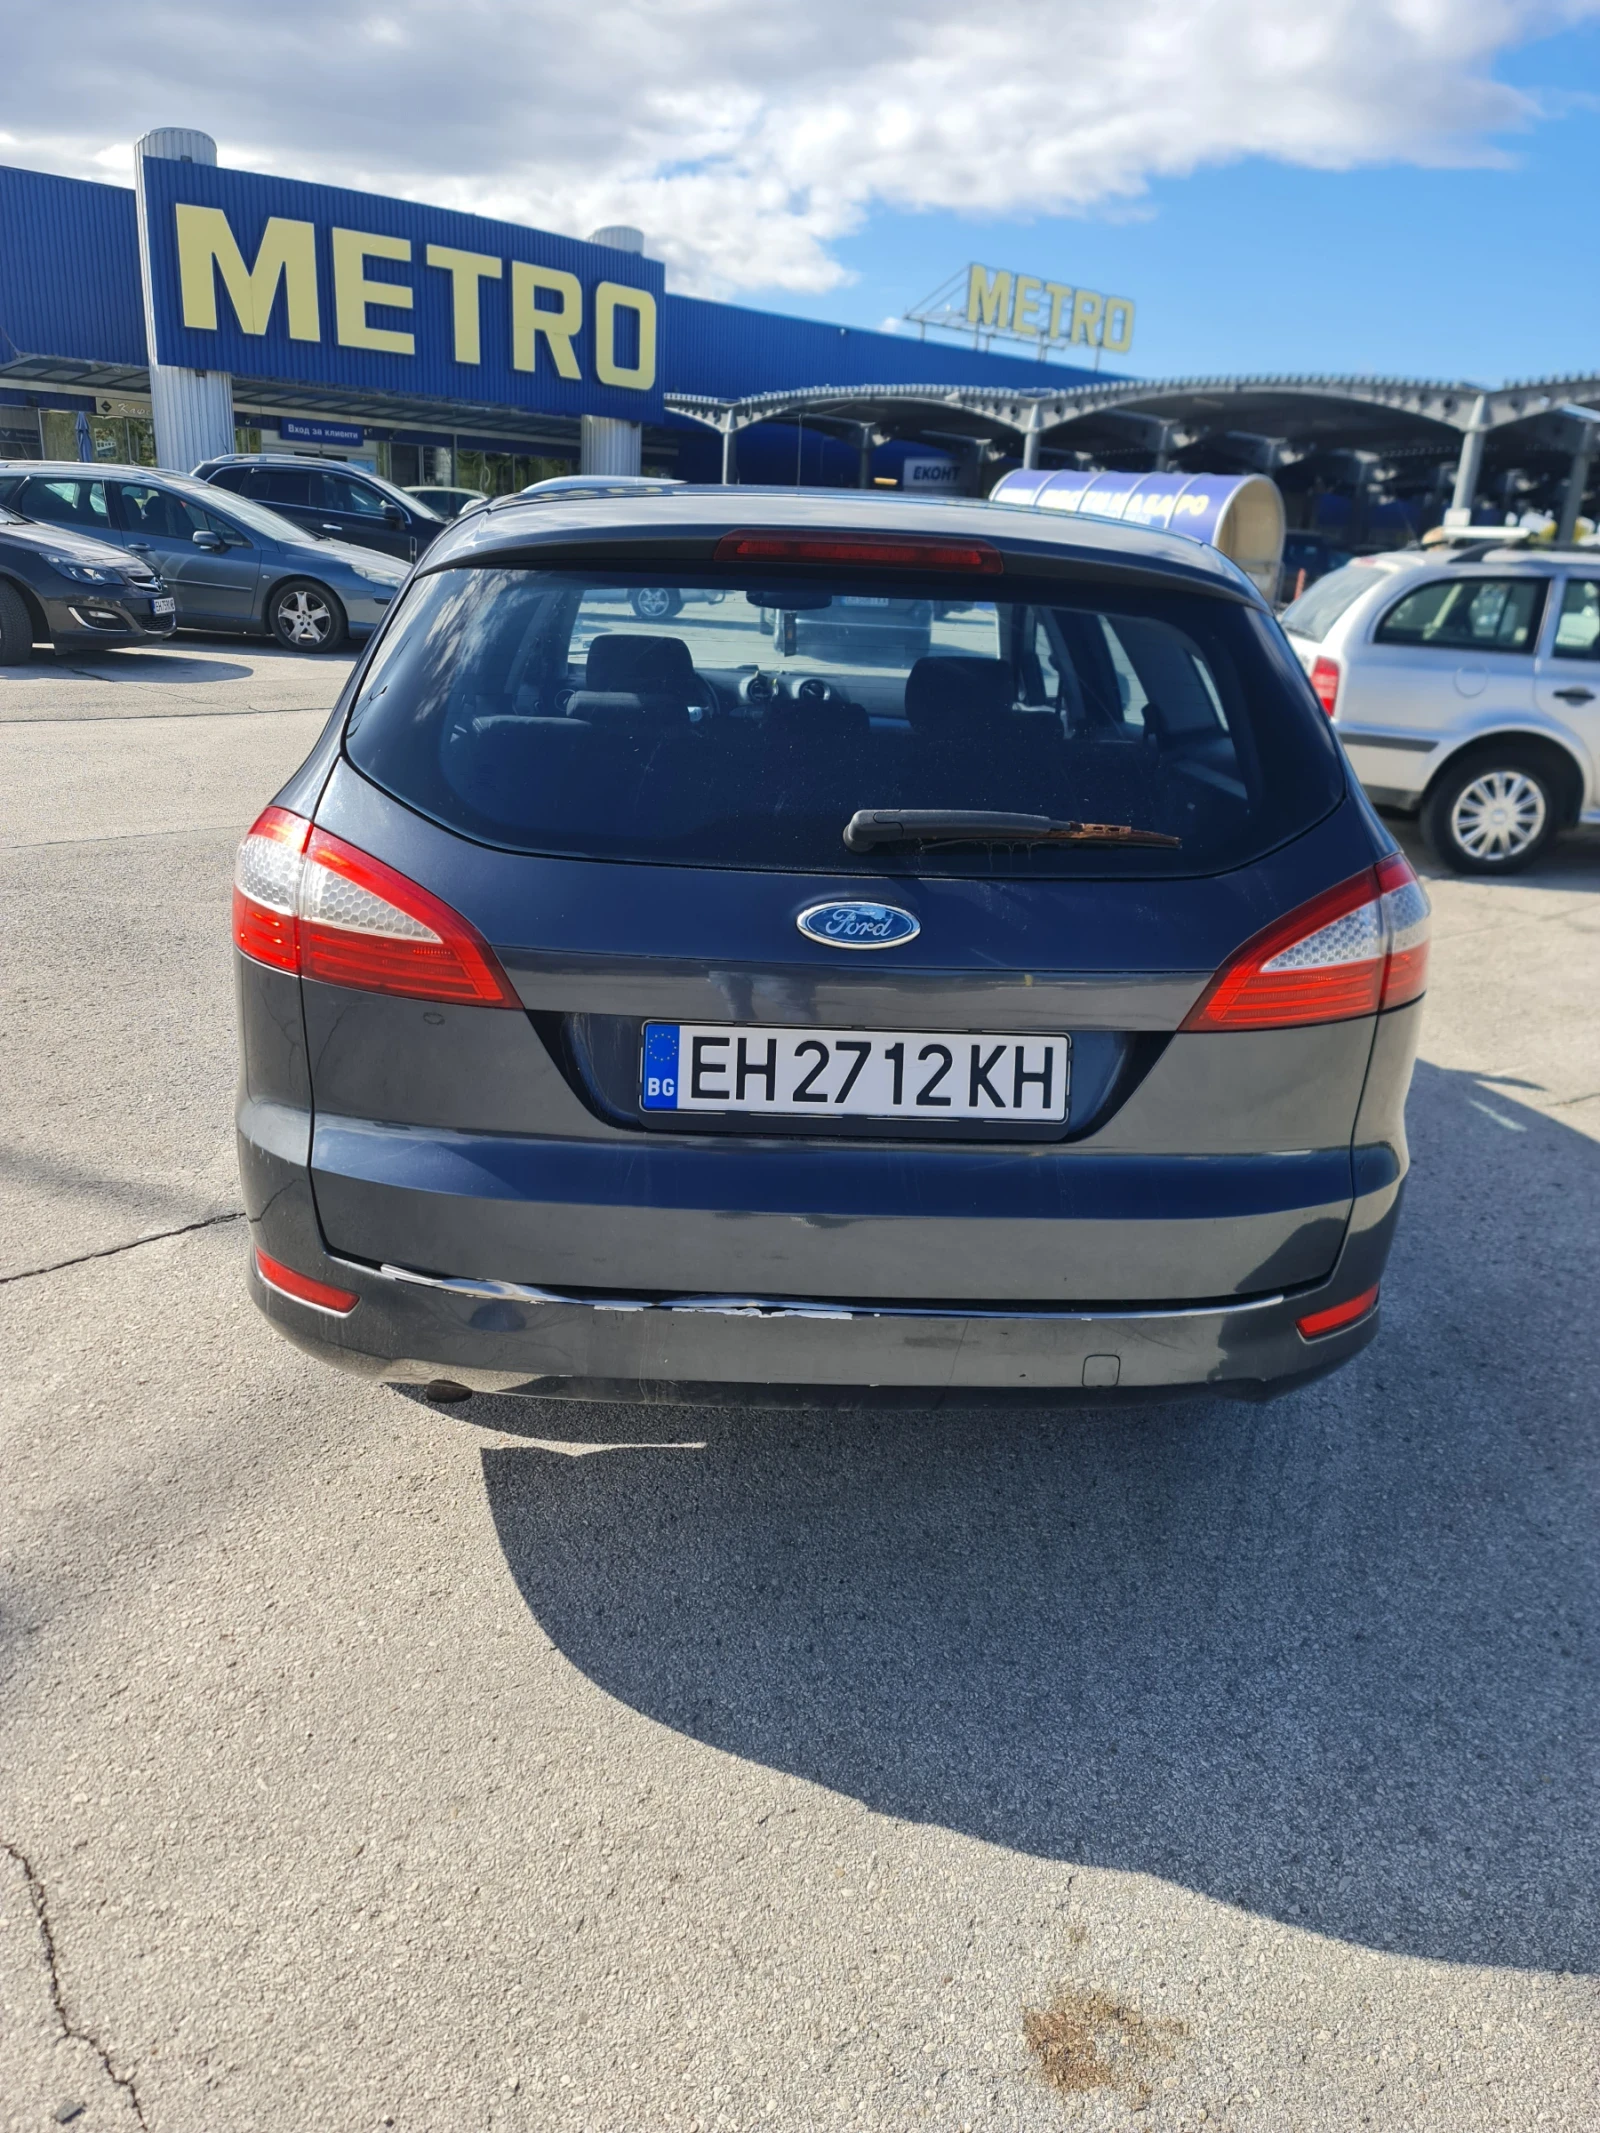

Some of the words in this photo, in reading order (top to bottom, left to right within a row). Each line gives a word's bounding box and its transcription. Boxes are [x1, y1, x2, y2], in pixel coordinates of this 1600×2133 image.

[175, 203, 657, 391] METRO
[967, 264, 1136, 354] METRO
[287, 423, 310, 435] Вход
[312, 427, 323, 436] за
[324, 429, 358, 439] клиенти
[913, 465, 961, 481] ЕКОНТ
[825, 909, 894, 936] Ford
[648, 1077, 675, 1097] BG
